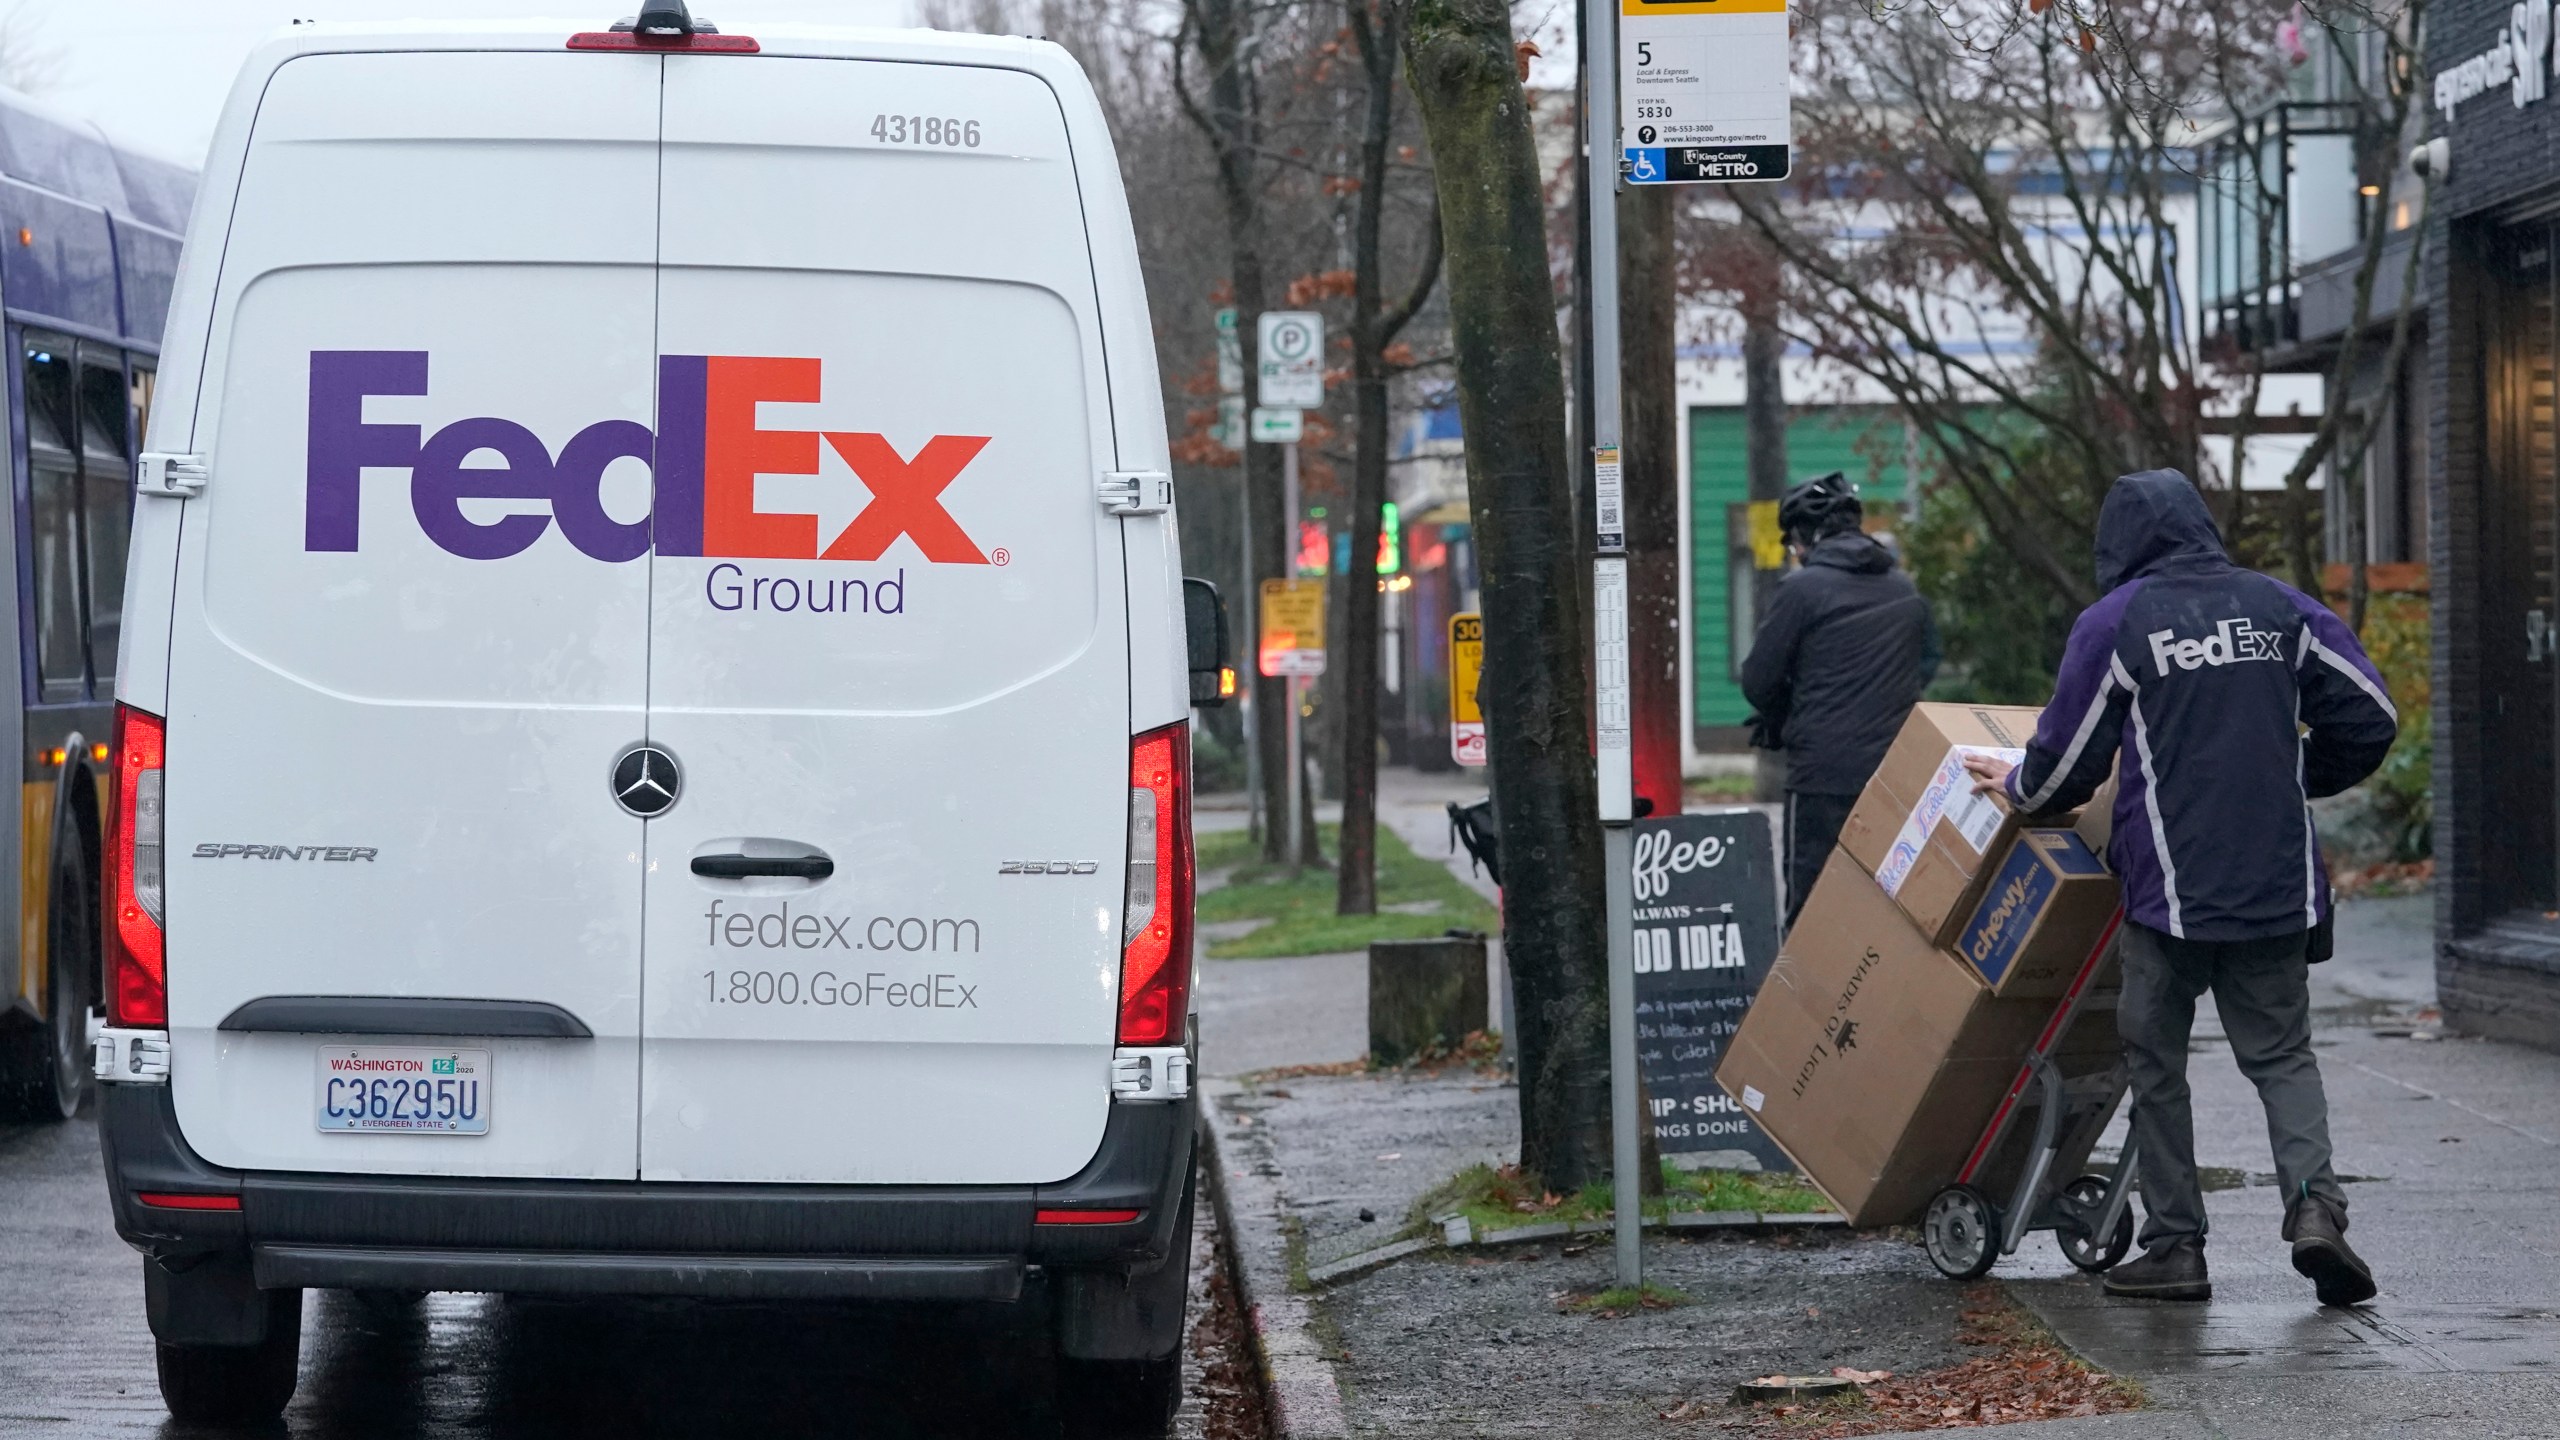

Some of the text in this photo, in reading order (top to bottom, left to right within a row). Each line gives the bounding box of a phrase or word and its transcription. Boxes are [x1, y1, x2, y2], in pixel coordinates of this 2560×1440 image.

[1637, 41, 1652, 66] 5
[1663, 69, 1689, 77] Express
[1637, 106, 1672, 118] 5830
[870, 114, 981, 148] 431866
[1663, 134, 1767, 143] www.kingcounty.gov/metro
[1699, 152, 1747, 162] King County
[1699, 163, 1758, 176] METRO
[304, 350, 991, 565] FedEx
[706, 563, 904, 614] Ground
[2148, 618, 2284, 677] FedEx
[192, 843, 379, 862] SPRINTER
[999, 860, 1099, 874] 2500
[1633, 829, 1726, 901] ffee
[705, 899, 980, 952] fedex.com
[1633, 922, 1746, 974] OD IDEA
[703, 970, 978, 1009] 1.800.GoFedEx
[1792, 946, 1880, 1100] SHADES OF LIGHT
[331, 1059, 423, 1072] WASHINGTON
[434, 1060, 451, 1071] 12
[327, 1077, 478, 1120] C36295U
[1649, 1097, 1677, 1117] IP
[362, 1120, 444, 1129] EVERGREEN STATE
[1654, 1119, 1749, 1139] NGS DONE
